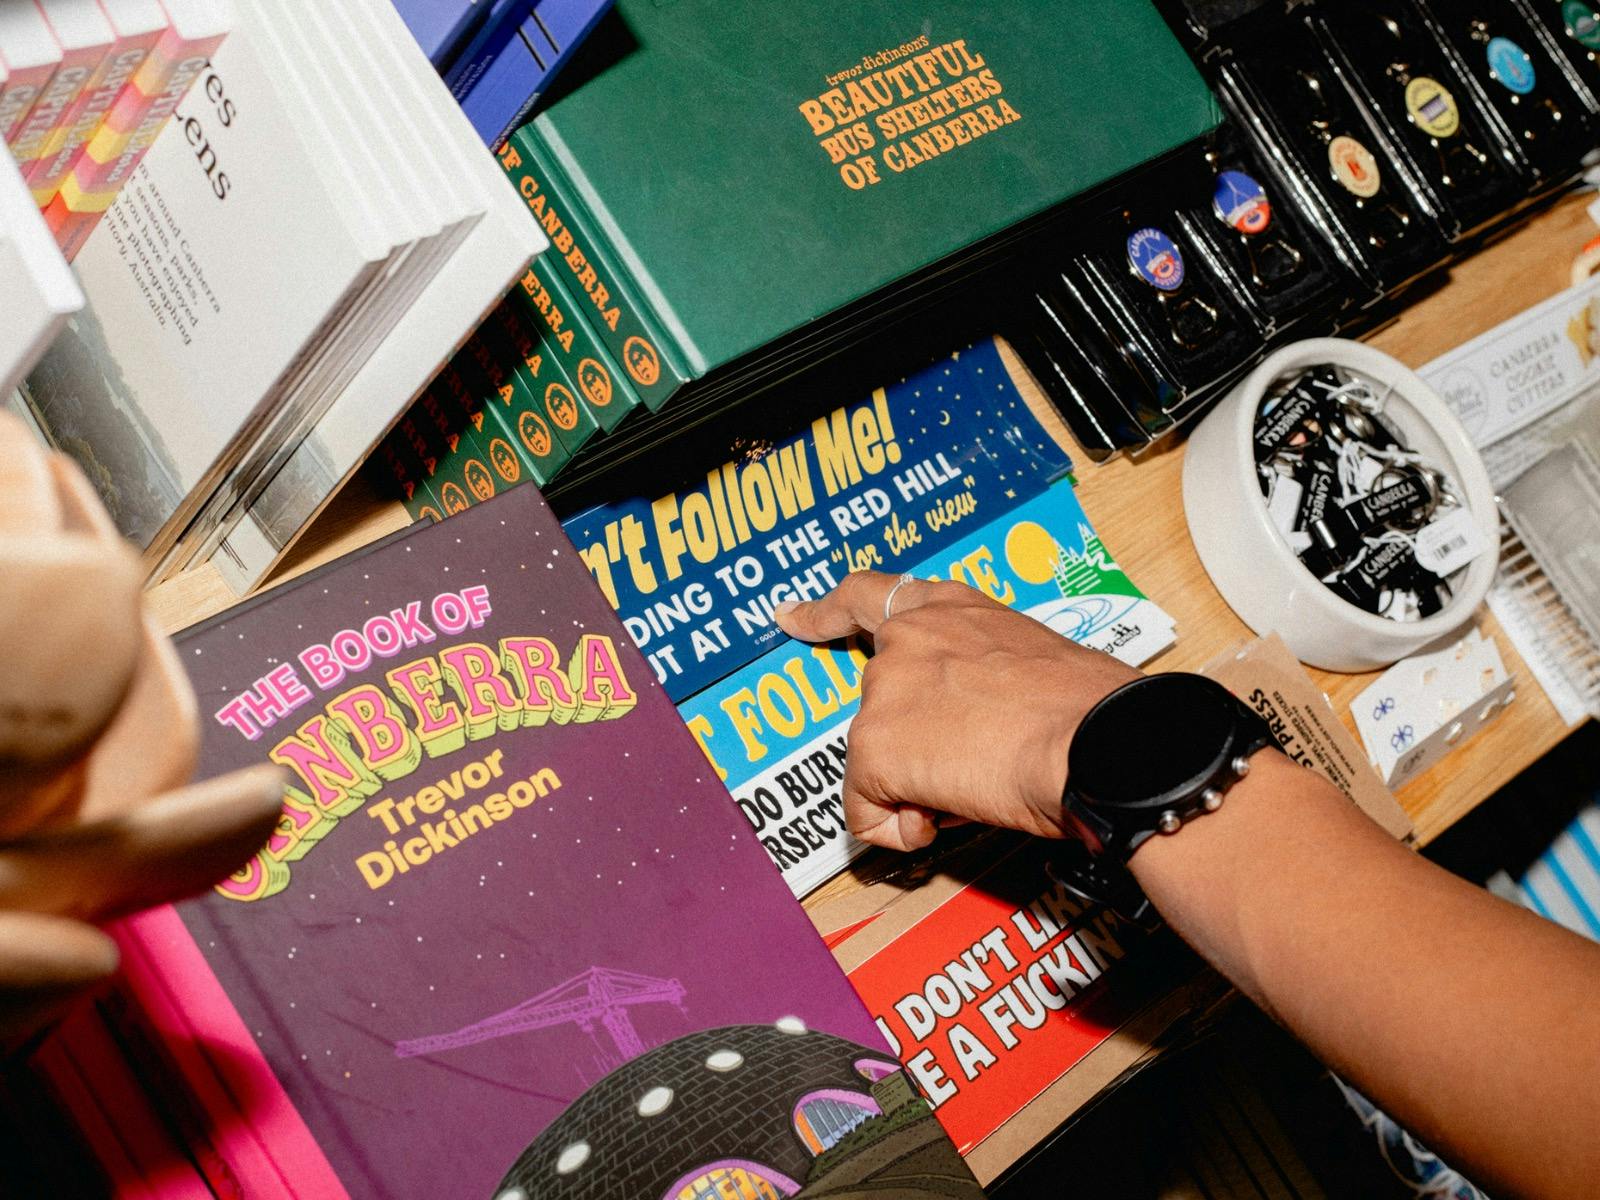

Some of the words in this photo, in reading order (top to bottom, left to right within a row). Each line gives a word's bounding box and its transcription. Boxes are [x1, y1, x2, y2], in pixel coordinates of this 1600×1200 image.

[798, 39, 985, 137] BEAUTIFUL
[825, 65, 863, 86] trevor
[863, 35, 929, 70] dickinson's
[819, 122, 876, 164] BUS
[875, 68, 1003, 140] SHELTERS
[840, 156, 881, 190] OF
[883, 98, 1022, 173] CANBERRA
[123, 194, 141, 225] you
[141, 224, 163, 264] have
[163, 267, 199, 328] enjoyed
[127, 232, 192, 346] photographing
[149, 183, 181, 239] around
[180, 239, 221, 314] Canberra
[520, 175, 621, 332] CANBERRA
[1260, 402, 1311, 448] CANBERRA
[652, 432, 824, 582] Follow
[811, 387, 902, 497] Me!
[715, 556, 764, 602] TO
[765, 522, 831, 570] THE
[836, 494, 893, 538] RED
[892, 452, 962, 504] HILL
[1368, 478, 1418, 511] CANBERRA
[690, 619, 732, 664] AT
[732, 559, 838, 636] NIGHT
[885, 515, 922, 560] the
[759, 630, 777, 643] GOLD
[215, 662, 312, 741] THE
[298, 600, 436, 691] BOOK
[431, 585, 493, 635] OF
[720, 643, 866, 763] FOLL
[1271, 689, 1293, 717] STICKER
[1248, 688, 1294, 746] PRESS
[1291, 717, 1312, 744] BUMPER
[355, 764, 562, 890] Dickinson
[367, 748, 505, 836] Trevor
[1009, 883, 1092, 952] LIK
[946, 1023, 998, 1081] A
